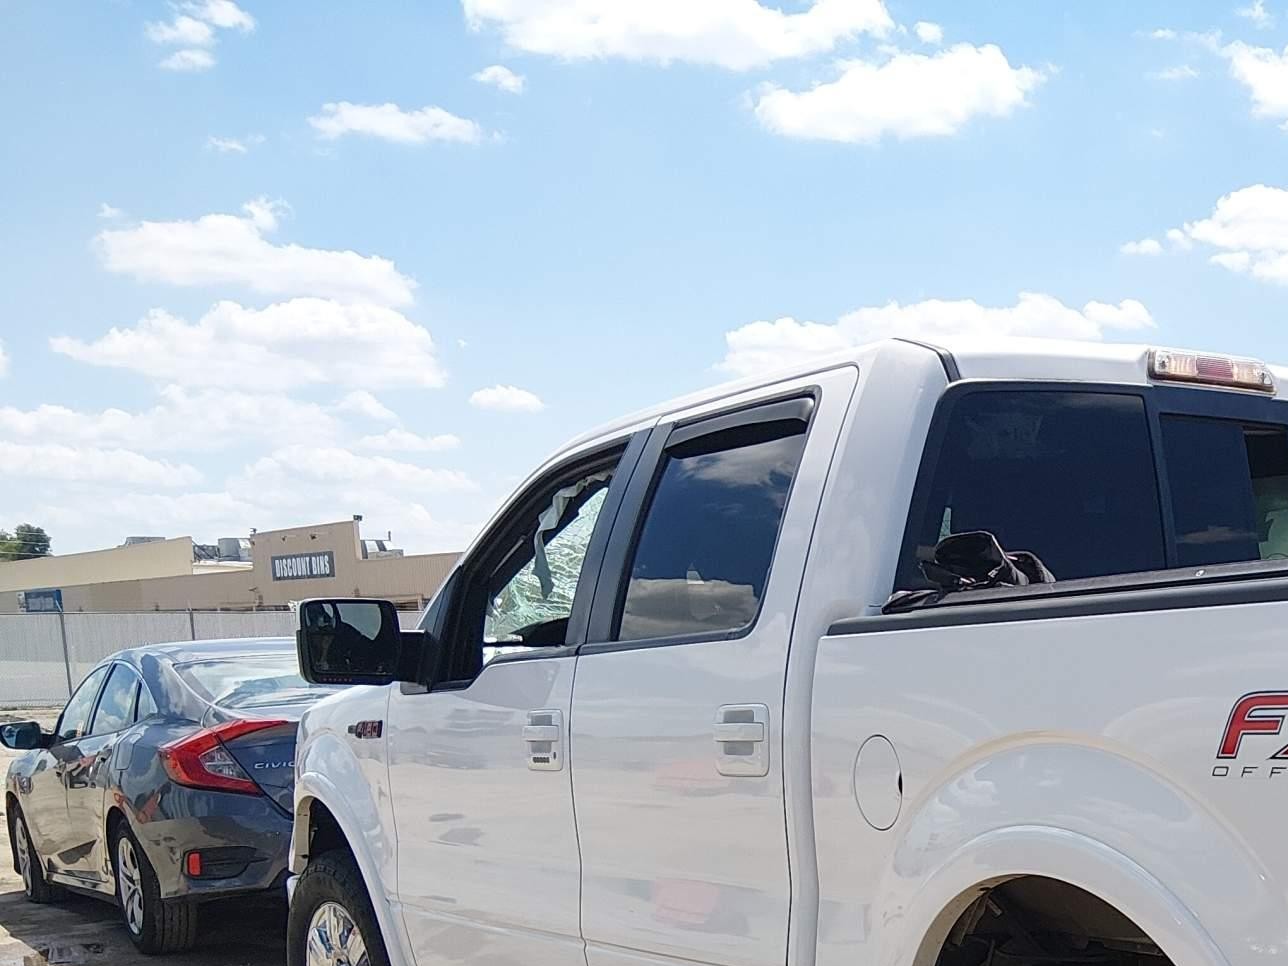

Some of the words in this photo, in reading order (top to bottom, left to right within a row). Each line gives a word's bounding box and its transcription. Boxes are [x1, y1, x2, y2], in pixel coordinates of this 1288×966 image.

[275, 557, 310, 578] DISCOUNT
[311, 555, 330, 575] BINS
[1211, 766, 1287, 779] OFF
